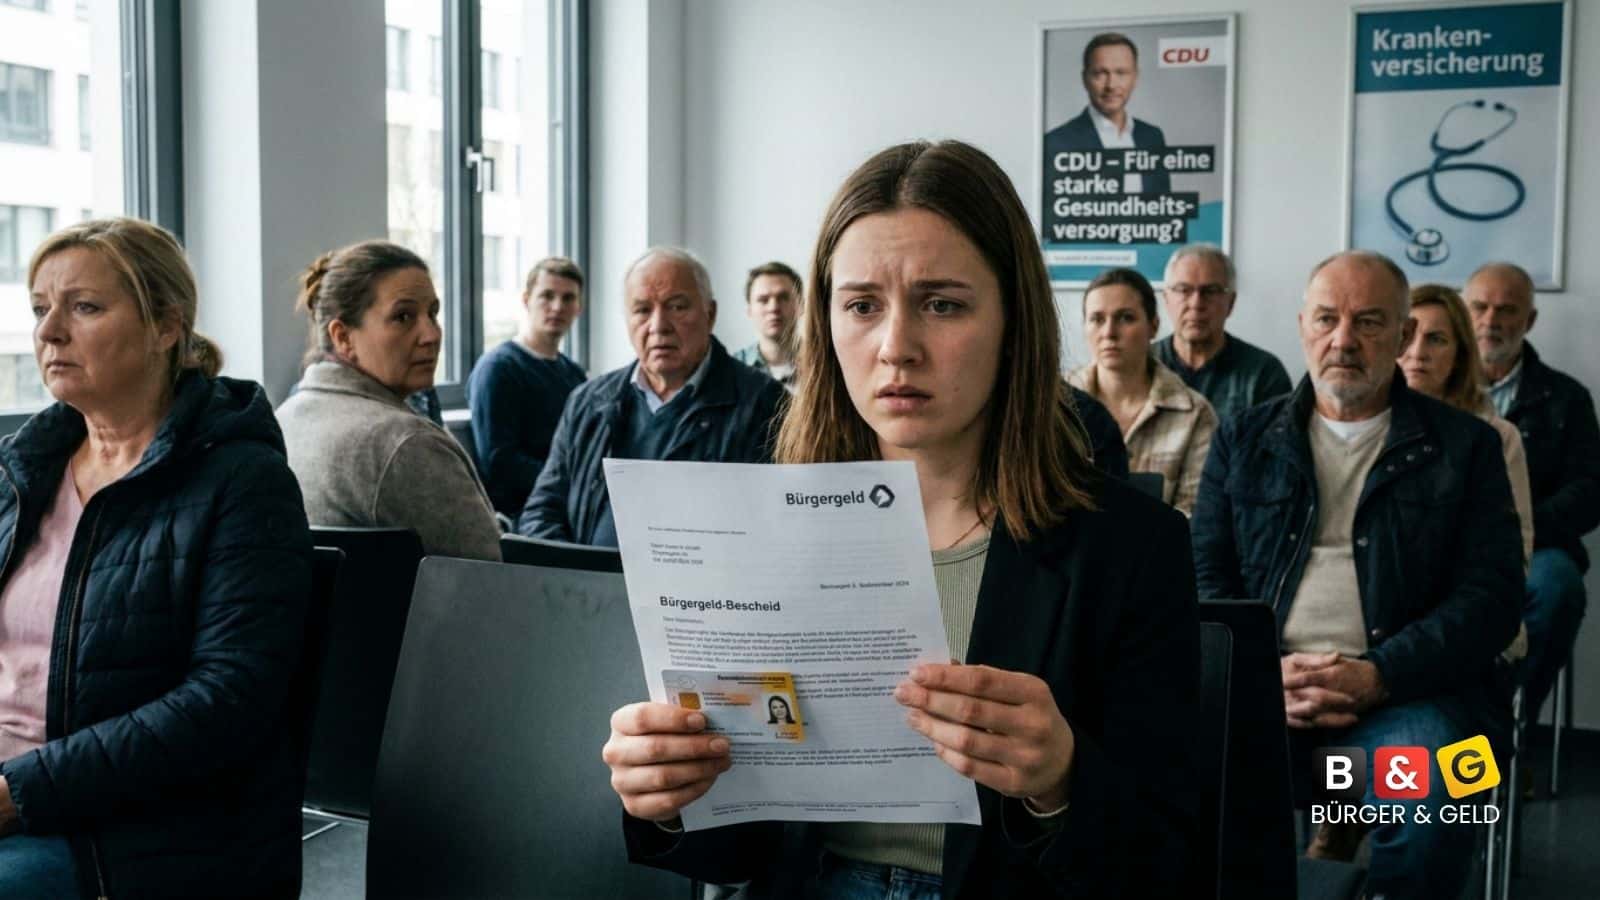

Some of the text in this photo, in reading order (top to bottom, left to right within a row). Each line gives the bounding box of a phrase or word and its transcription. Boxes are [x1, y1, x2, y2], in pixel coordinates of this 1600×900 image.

[1372, 25, 1492, 51] Kranken-
[1163, 48, 1210, 64] CDU
[1371, 51, 1544, 77] versicherung
[1053, 152, 1102, 172] CDU
[1124, 150, 1160, 171] Für
[1163, 149, 1211, 169] eine
[1053, 174, 1119, 194] starke
[1053, 193, 1195, 217] Gesundheits-
[1053, 219, 1184, 244] versorgung?
[785, 491, 866, 508] Bürgergeld
[659, 595, 781, 613] Bürgergeld-Bescheid
